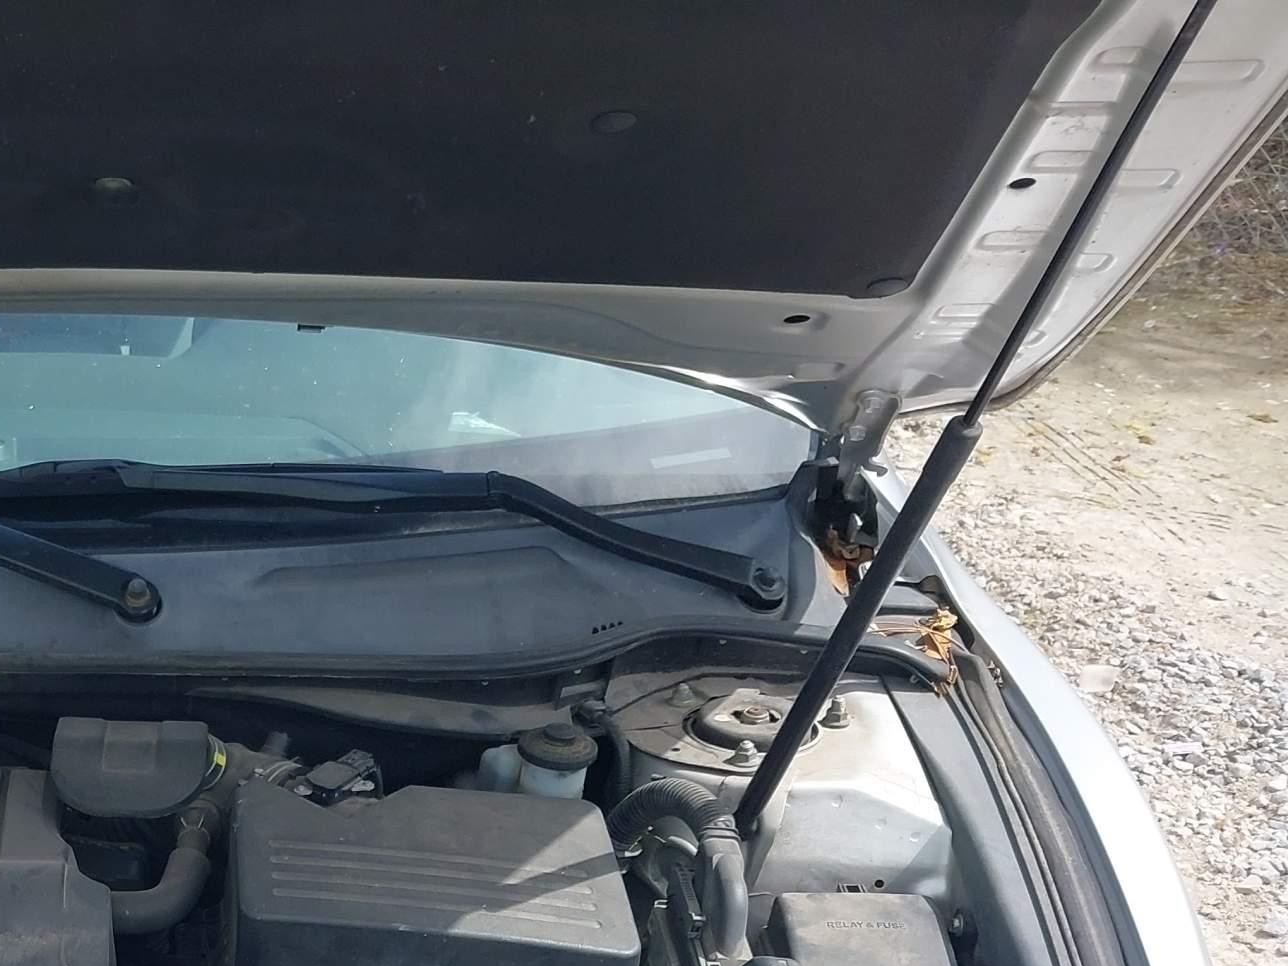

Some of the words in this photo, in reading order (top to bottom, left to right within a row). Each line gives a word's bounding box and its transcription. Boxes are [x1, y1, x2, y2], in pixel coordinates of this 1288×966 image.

[826, 920, 864, 929] RELAY
[866, 921, 874, 929] &
[877, 920, 905, 930] FUSE
